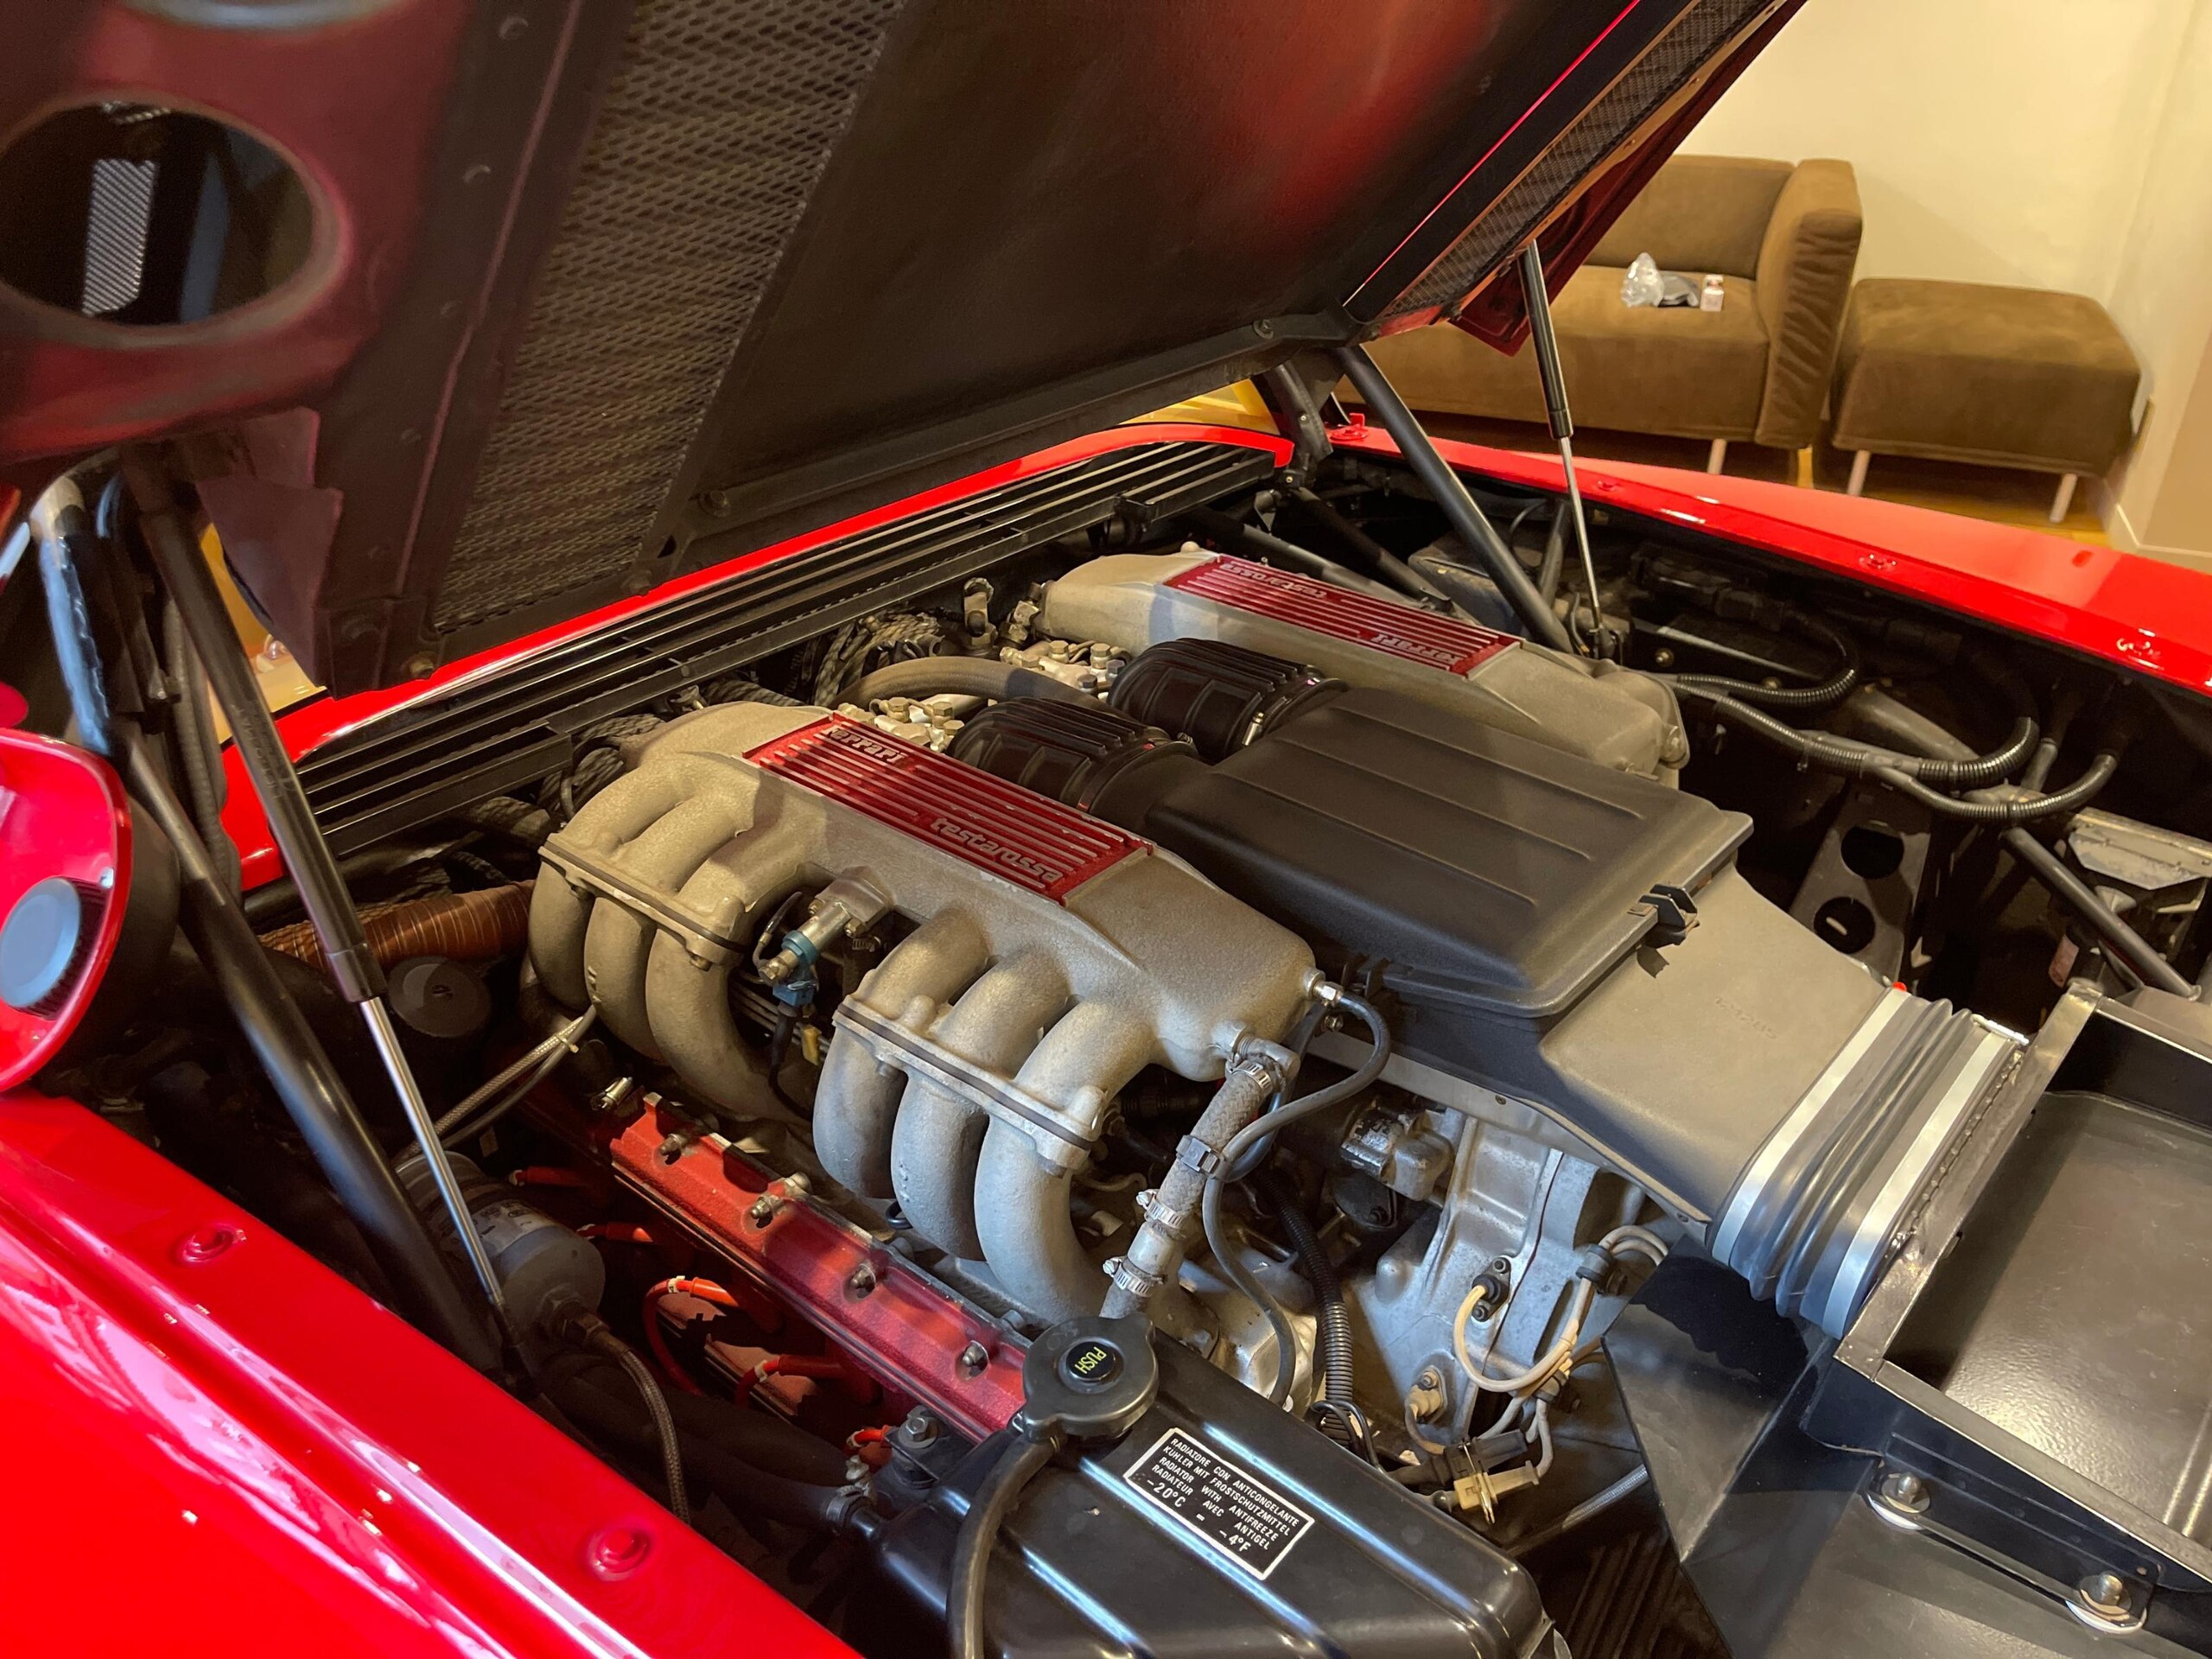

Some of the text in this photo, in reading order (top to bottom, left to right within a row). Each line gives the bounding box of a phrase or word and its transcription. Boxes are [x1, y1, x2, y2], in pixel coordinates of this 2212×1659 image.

[1219, 563, 1327, 599] testarossa
[931, 817, 1064, 883] testarossa
[1074, 1346, 1107, 1375] PUSH
[1152, 1465, 1270, 1550] RADIATEUR AVEC ANTIGEL
[1159, 1457, 1279, 1541] RADIATOR WITH ANTIFREEZE
[1193, 1465, 1211, 1478] MIT
[1210, 1477, 1290, 1536] FROSTSCHUTZMITTEL
[1213, 1466, 1231, 1481] CON
[1232, 1479, 1300, 1527] ANTICONGELANTE
